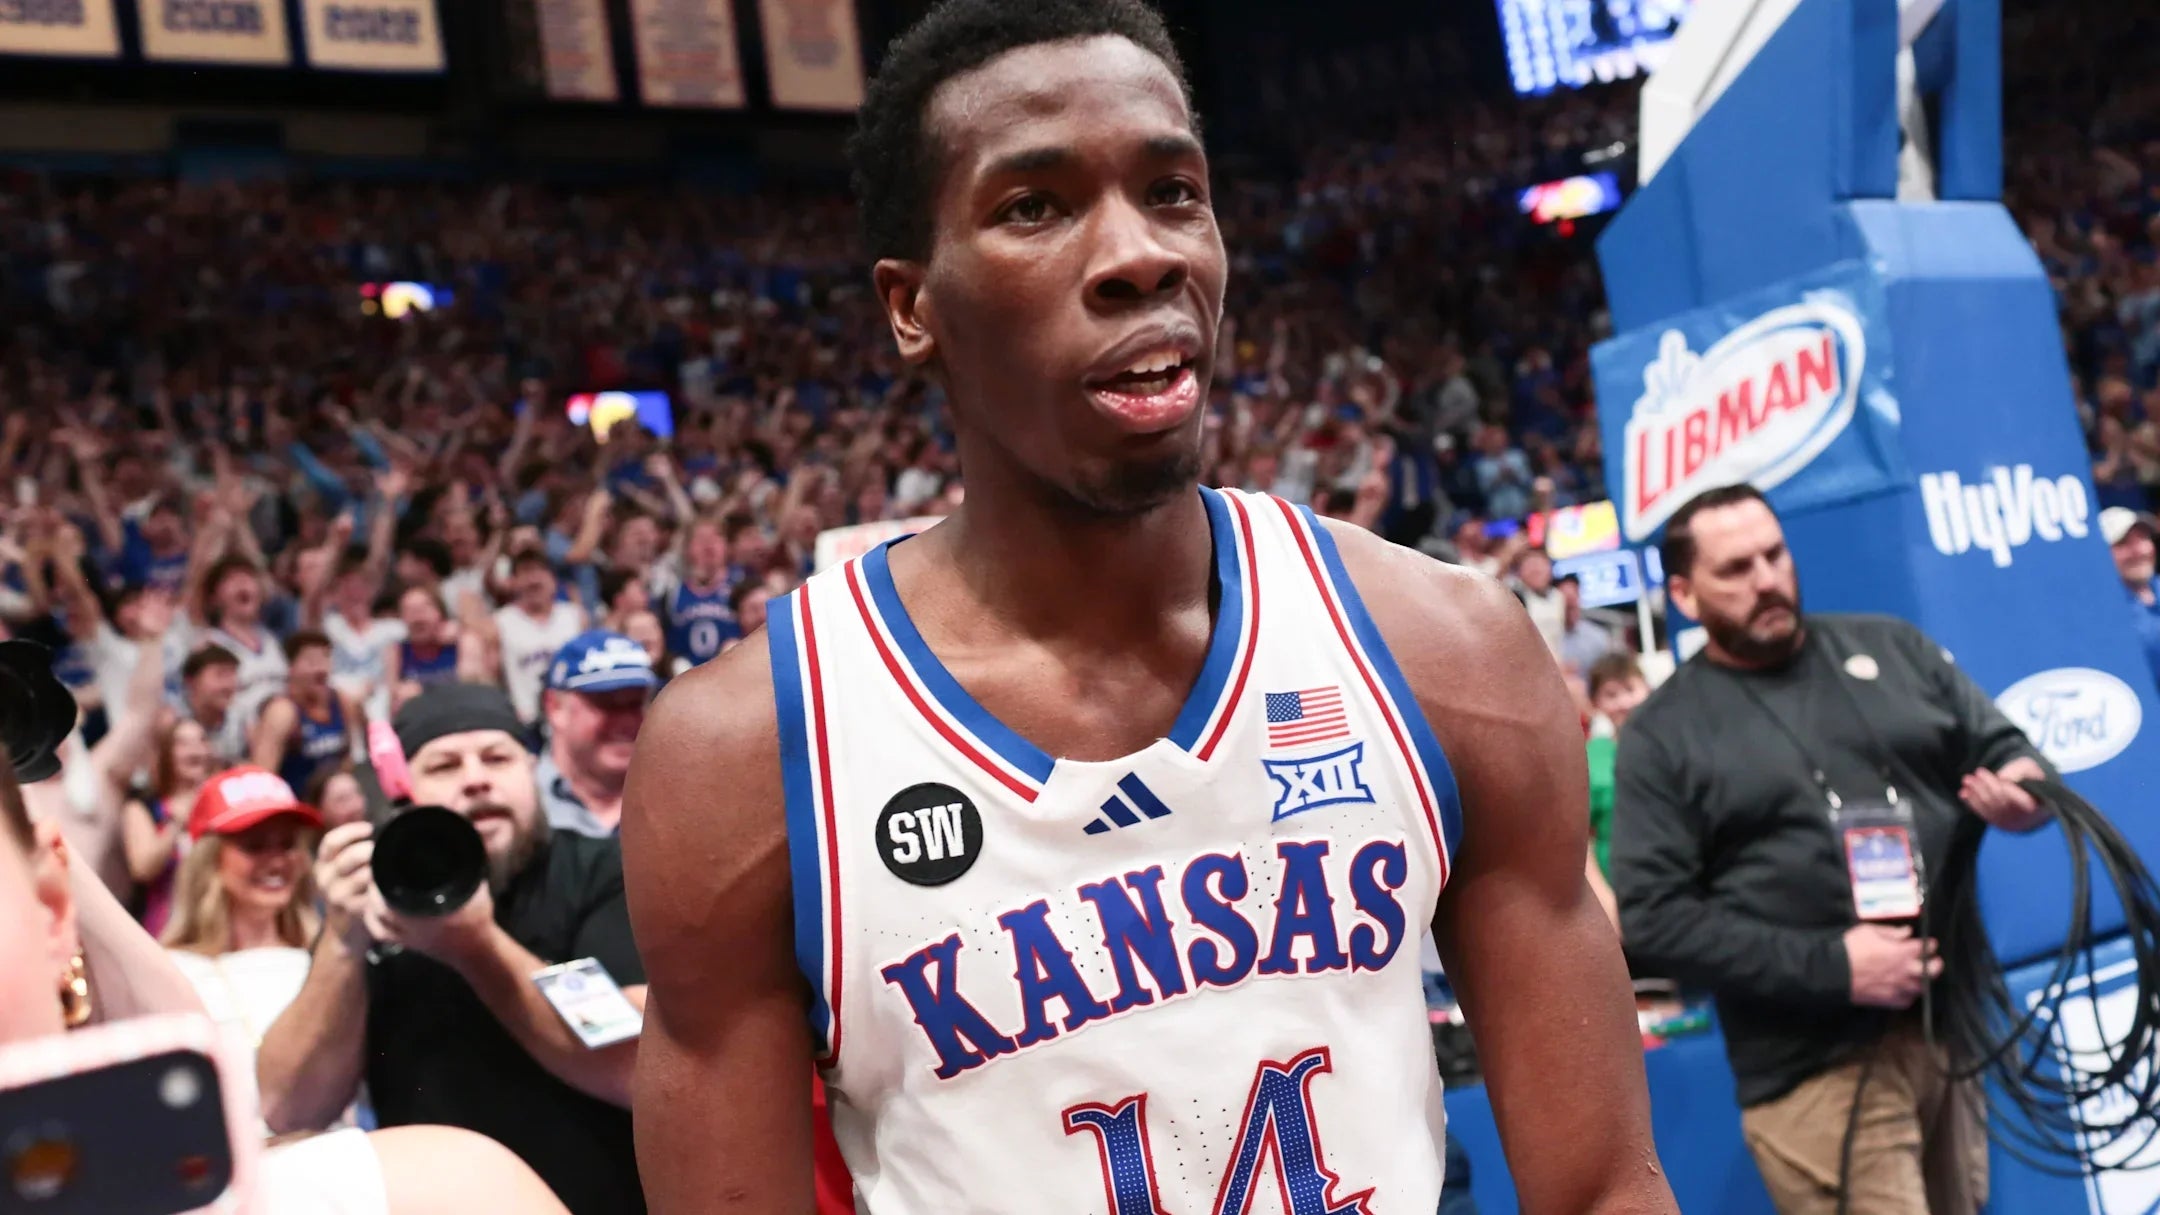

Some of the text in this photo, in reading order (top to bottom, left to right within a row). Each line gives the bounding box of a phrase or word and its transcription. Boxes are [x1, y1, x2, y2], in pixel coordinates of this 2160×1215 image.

[1636, 334, 1834, 518] LIBMAN
[1919, 463, 2090, 568] HyVee
[2026, 687, 2107, 752] Ford
[887, 802, 965, 865] SW
[1261, 740, 1377, 824] XII
[880, 839, 1409, 1081] KANSAS
[1061, 1045, 1377, 1215] 14
